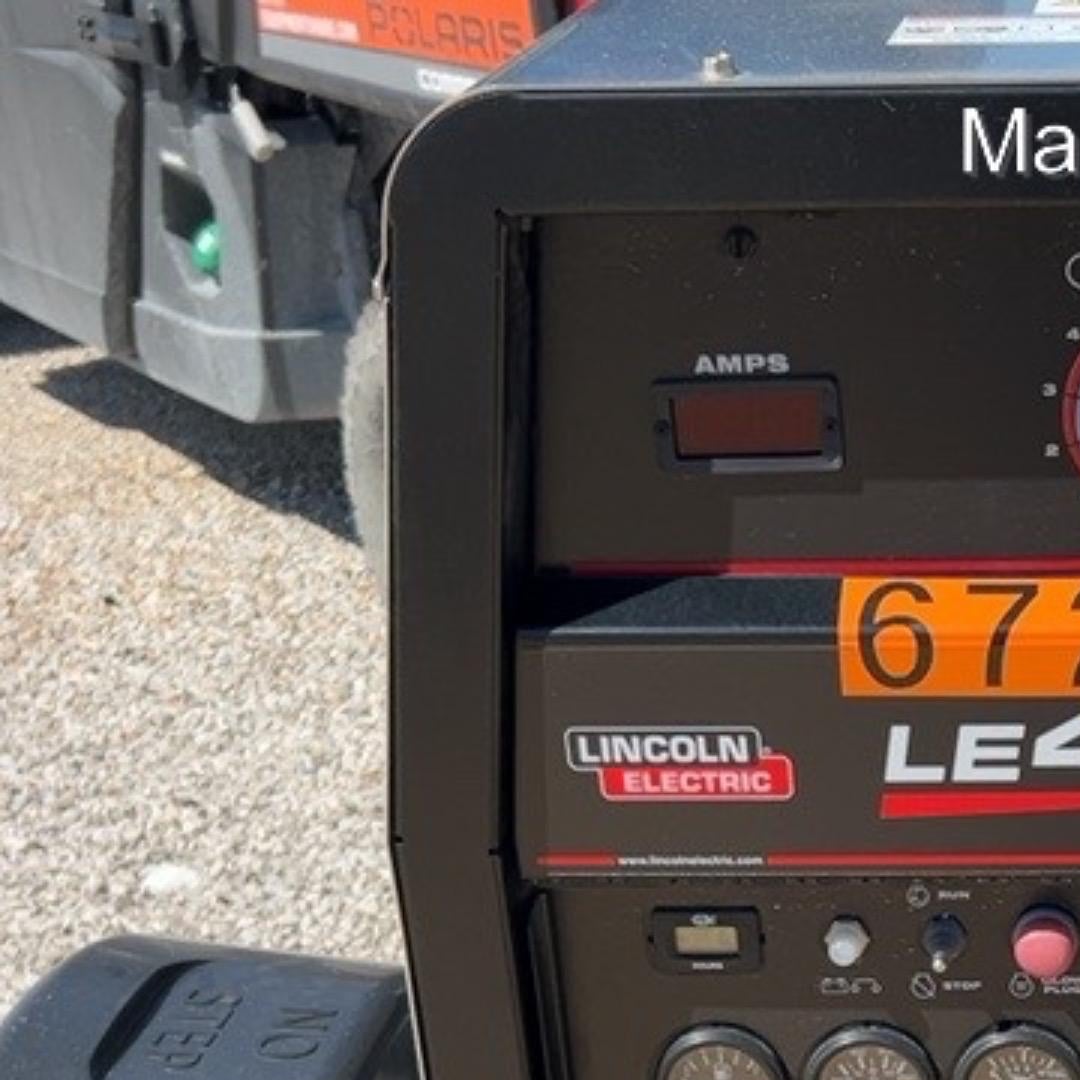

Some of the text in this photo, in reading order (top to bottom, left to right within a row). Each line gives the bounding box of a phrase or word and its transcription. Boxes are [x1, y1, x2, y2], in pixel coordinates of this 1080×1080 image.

[367, 2, 526, 57] POLARIS
[1066, 328, 1080, 341] 4
[695, 354, 790, 374] AMPS
[1042, 383, 1058, 397] 3
[1044, 444, 1060, 457] 2
[577, 735, 749, 764] LINCOLN
[622, 771, 772, 794] ELECTRIC
